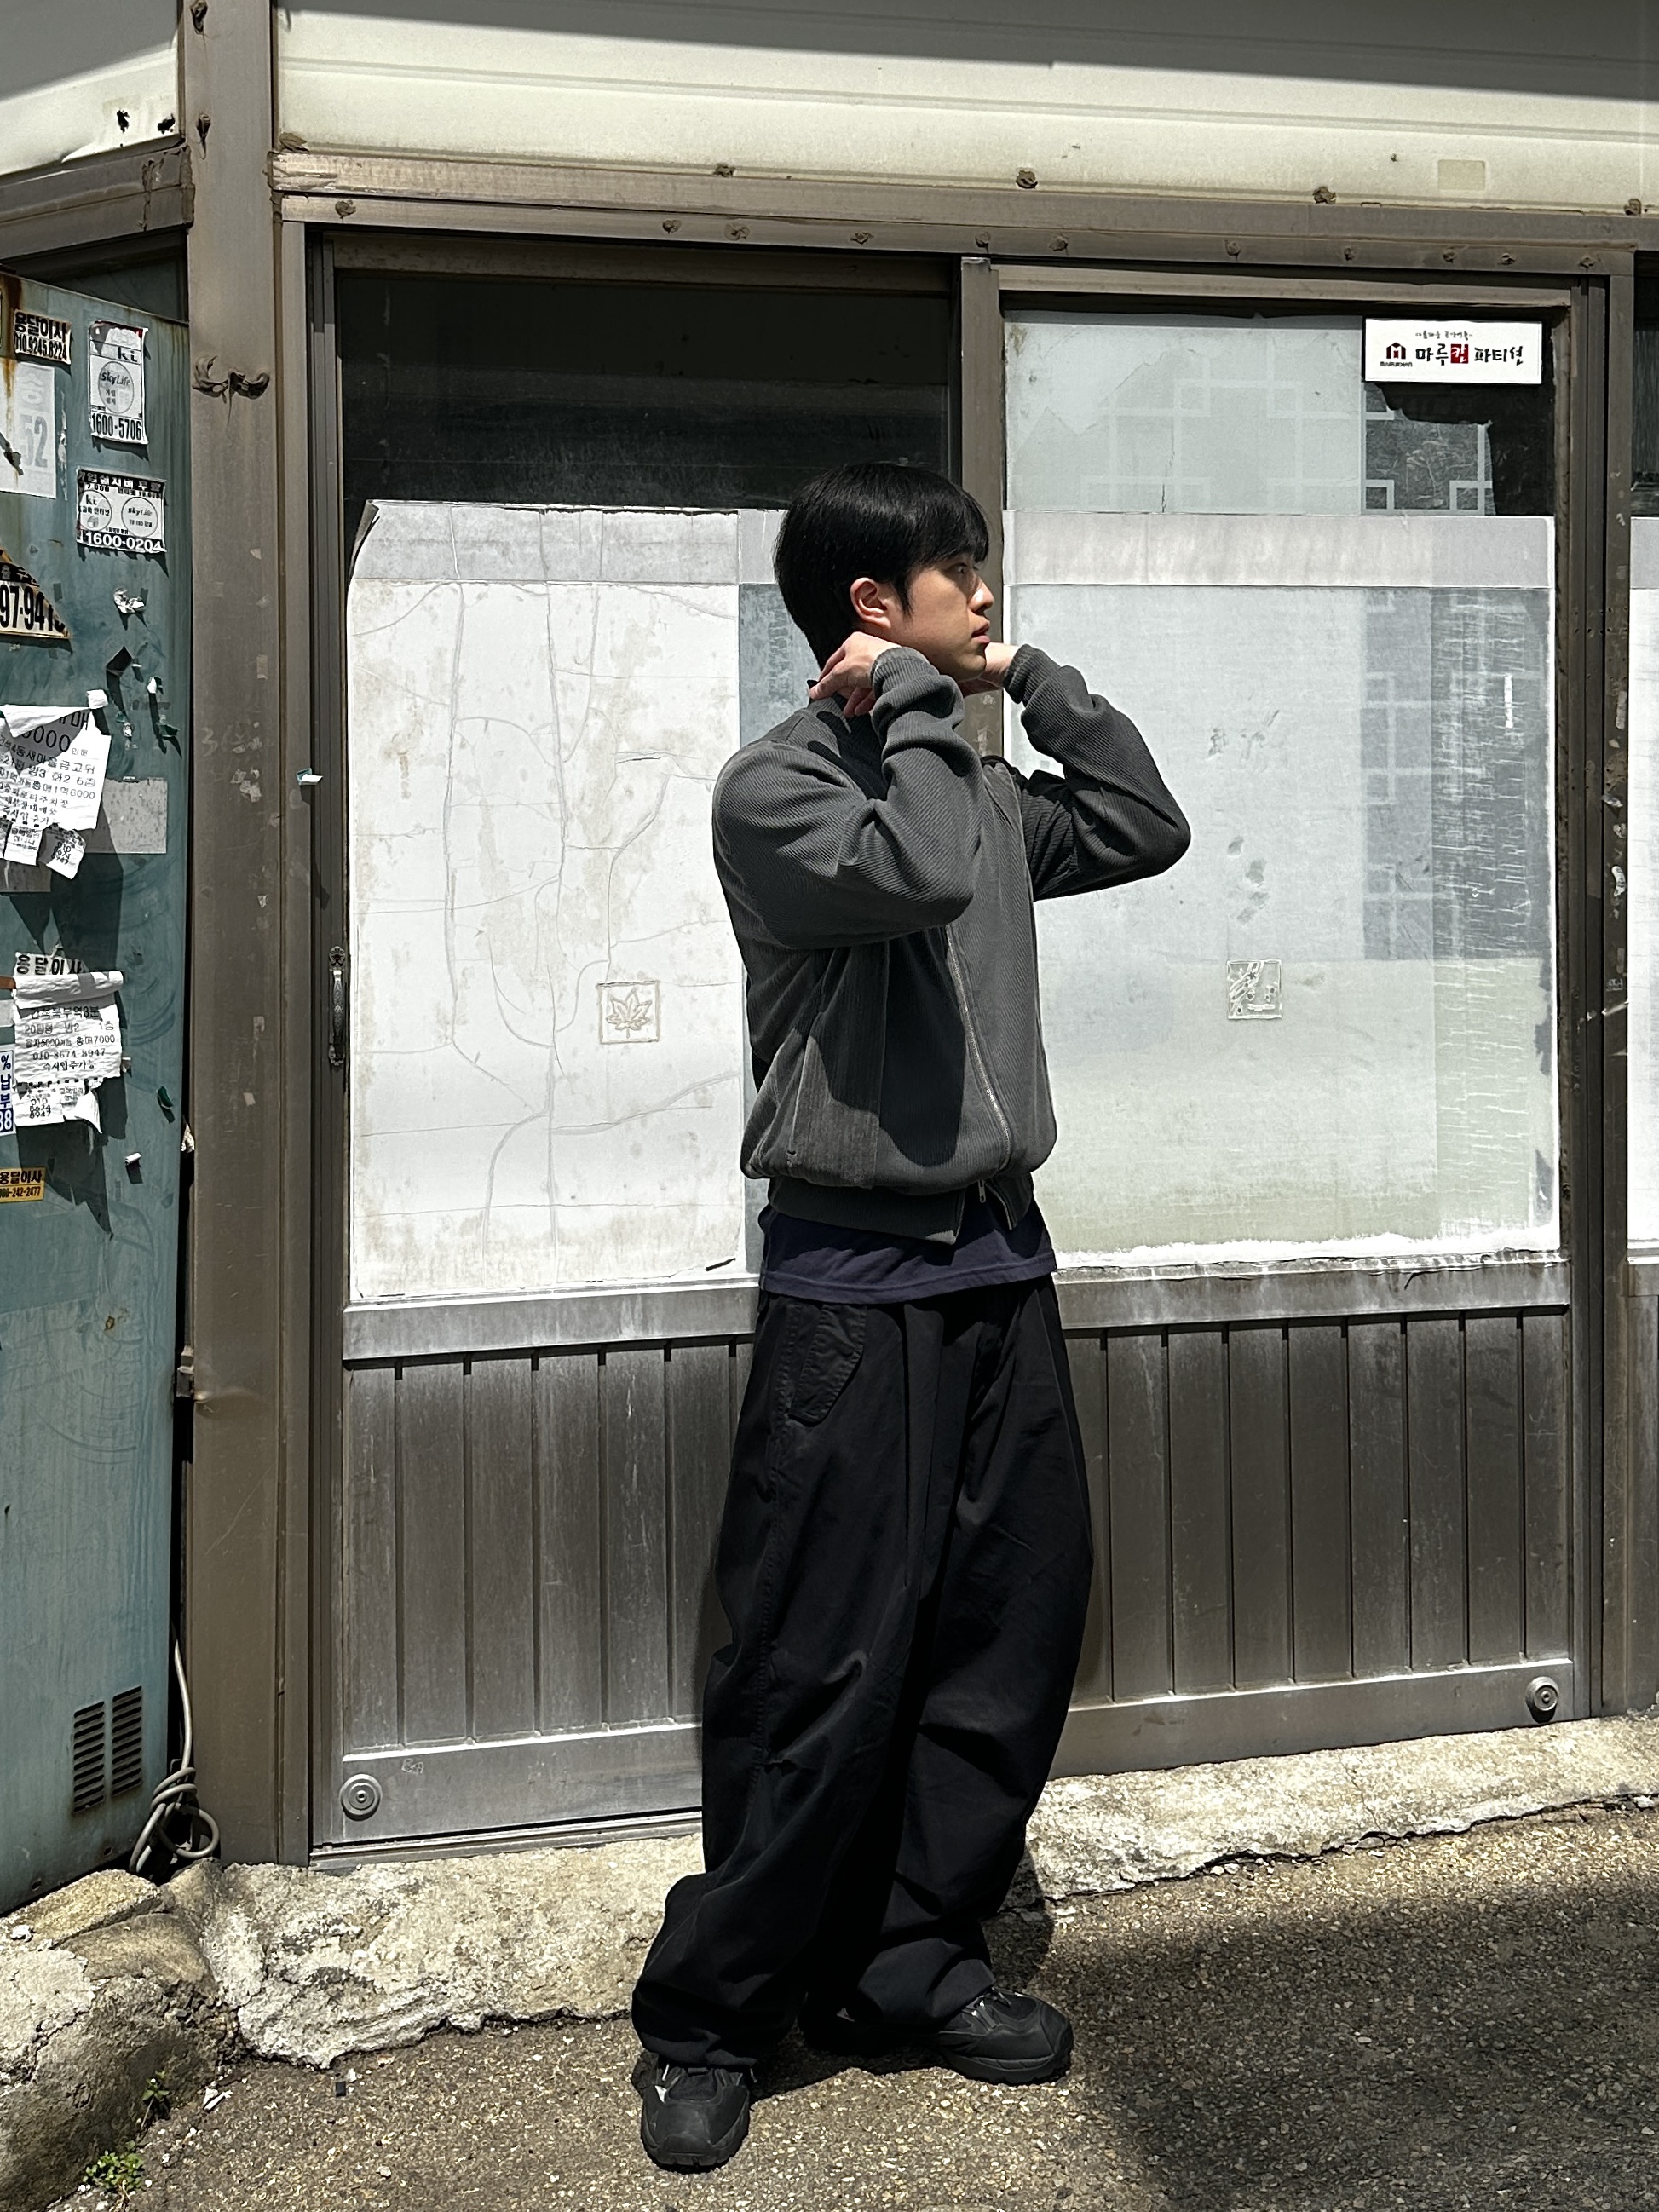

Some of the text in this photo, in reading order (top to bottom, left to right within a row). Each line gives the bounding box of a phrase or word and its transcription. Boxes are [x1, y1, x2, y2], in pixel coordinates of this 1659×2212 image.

[15, 312, 67, 343] 용달이사
[1474, 345, 1524, 366] 파티션
[91, 413, 142, 441] 1600-5706
[86, 531, 161, 552] 1600-0204
[17, 954, 83, 975] 용달이사
[0, 1170, 42, 1184] 용달이사
